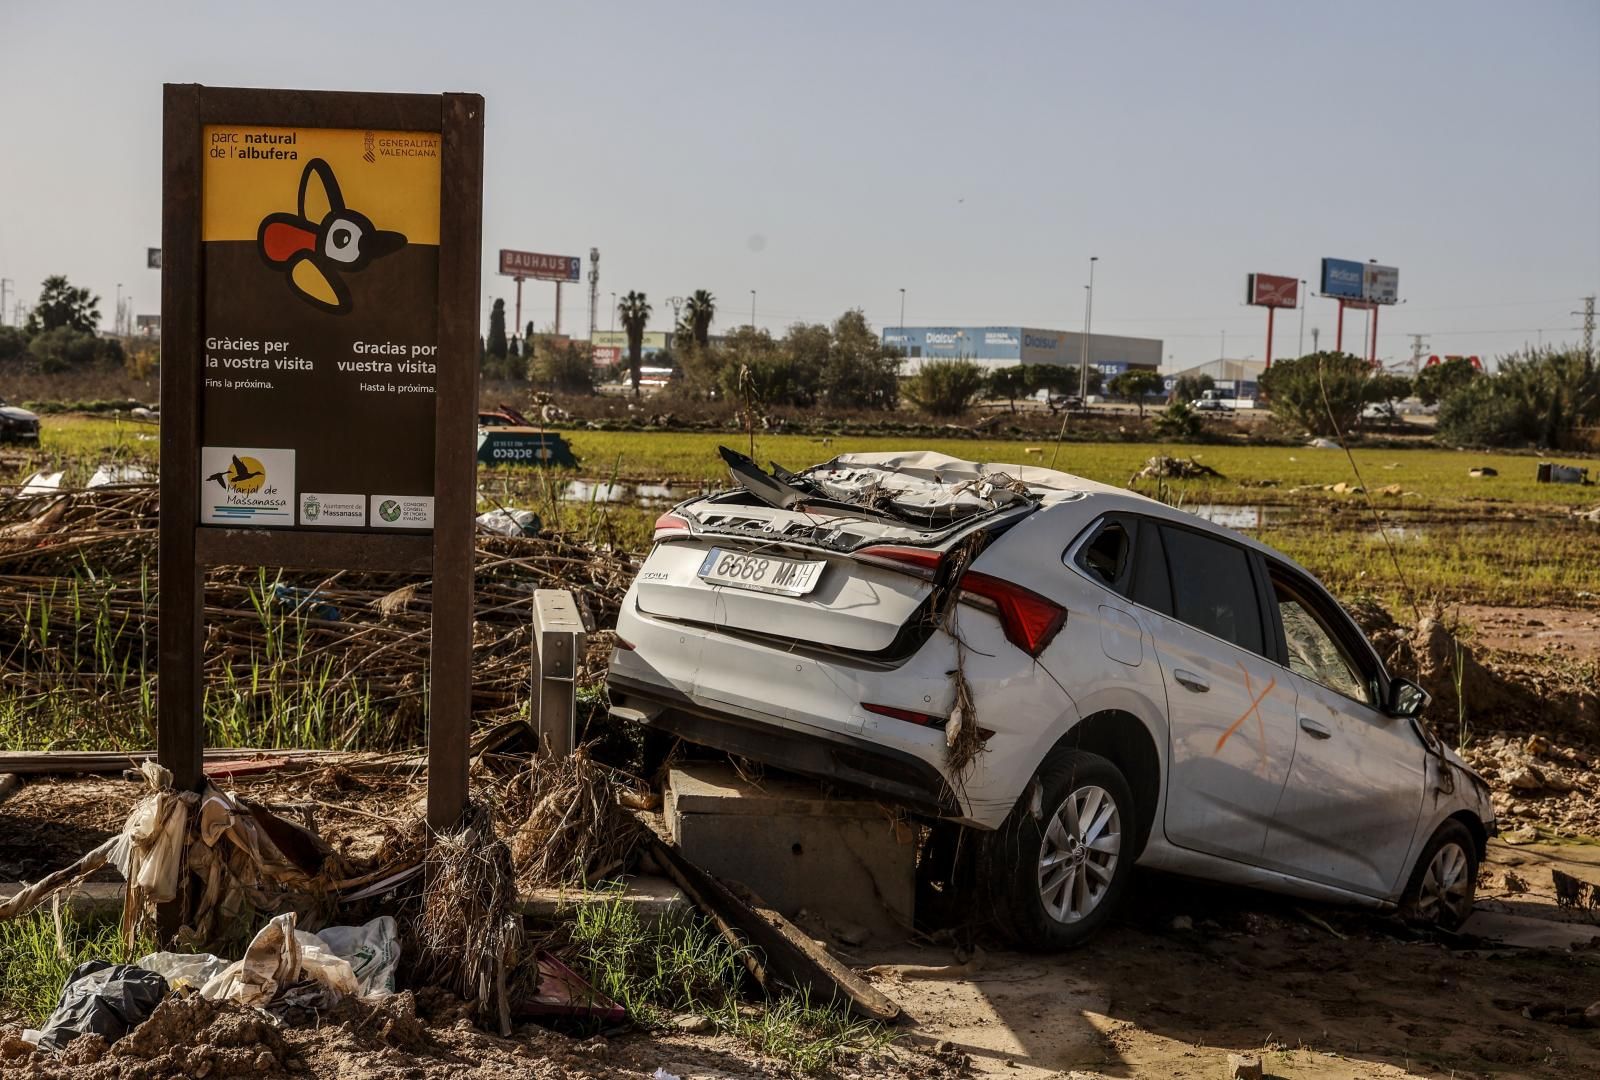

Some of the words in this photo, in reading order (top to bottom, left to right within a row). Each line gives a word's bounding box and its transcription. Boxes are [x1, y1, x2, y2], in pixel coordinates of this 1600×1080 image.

[211, 133, 239, 145] parc
[244, 132, 297, 144] natural
[378, 139, 439, 148] GENERALITAT
[209, 145, 226, 158] de
[379, 148, 437, 157] VALENCIANA
[506, 252, 566, 270] BAUHAUS
[205, 337, 260, 351] Gràcies
[264, 341, 290, 354] per
[352, 341, 407, 355] Gracias
[411, 345, 438, 359] por
[205, 354, 219, 368] la
[223, 357, 270, 369] vostra
[275, 357, 314, 370] visita
[336, 360, 393, 372] vuestra
[397, 360, 437, 373] visita
[205, 379, 223, 388] Fins
[224, 379, 232, 388] la
[359, 382, 386, 392] Hasta
[387, 383, 396, 392] la
[493, 448, 533, 460] acteco
[227, 484, 259, 498] Marjal
[264, 484, 278, 495] de
[226, 495, 287, 506] Massanassa
[716, 554, 769, 581] 6668
